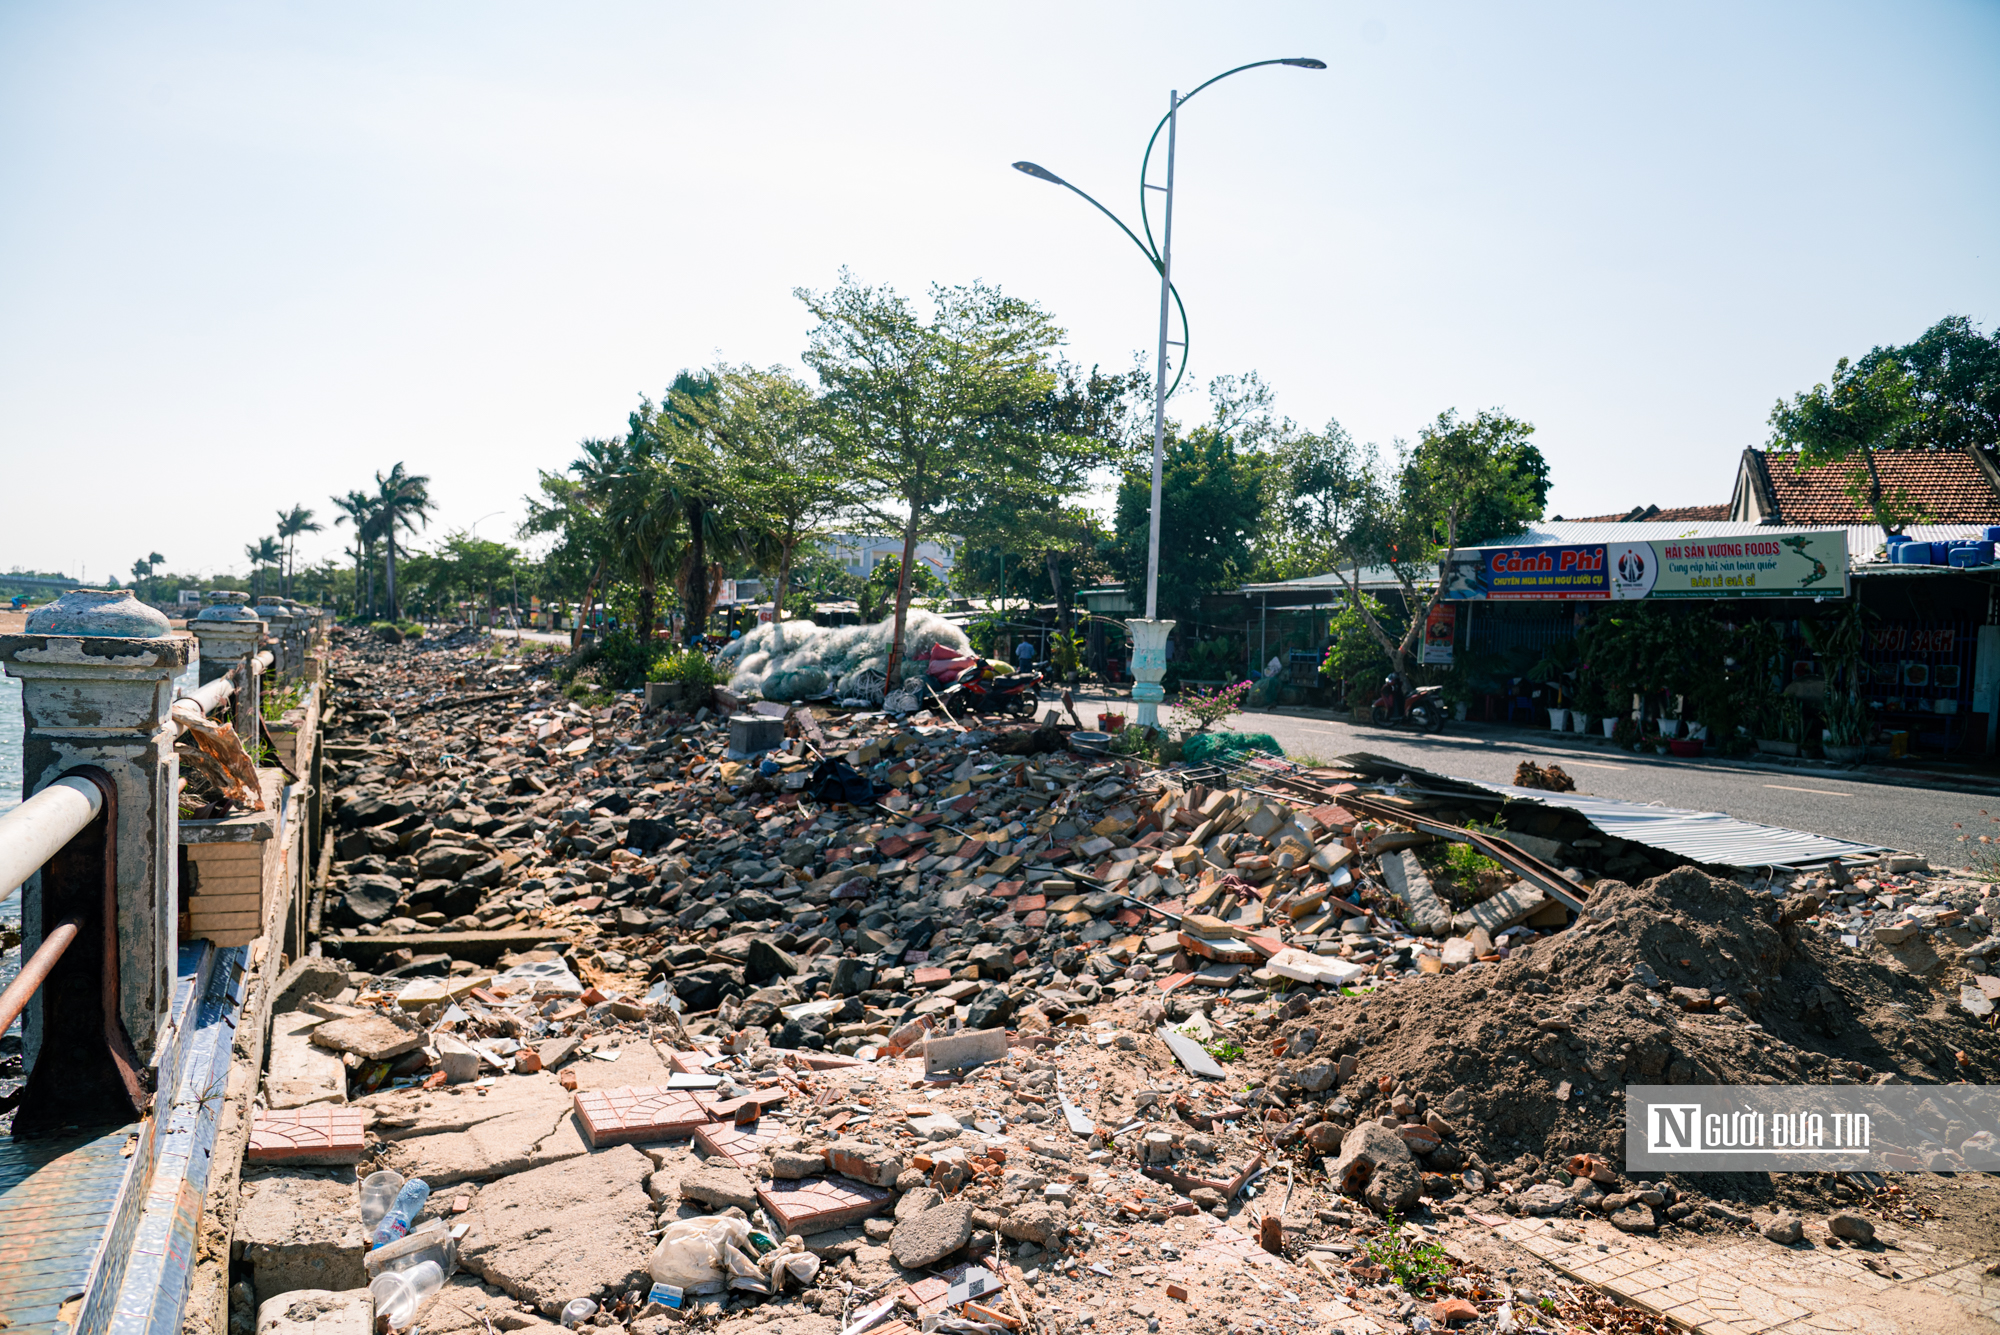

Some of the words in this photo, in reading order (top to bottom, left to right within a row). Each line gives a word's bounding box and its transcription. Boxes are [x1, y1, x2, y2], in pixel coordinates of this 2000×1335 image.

[1707, 542, 1742, 558] VƯƠNG
[1744, 541, 1781, 557] FOODS
[1492, 551, 1553, 573] Cảnh
[1559, 547, 1604, 571] Phi
[1669, 562, 1689, 575] Cung
[1521, 576, 1537, 585] MUA
[1691, 575, 1711, 587] BÁN
[1910, 629, 1956, 659] SẠCH
